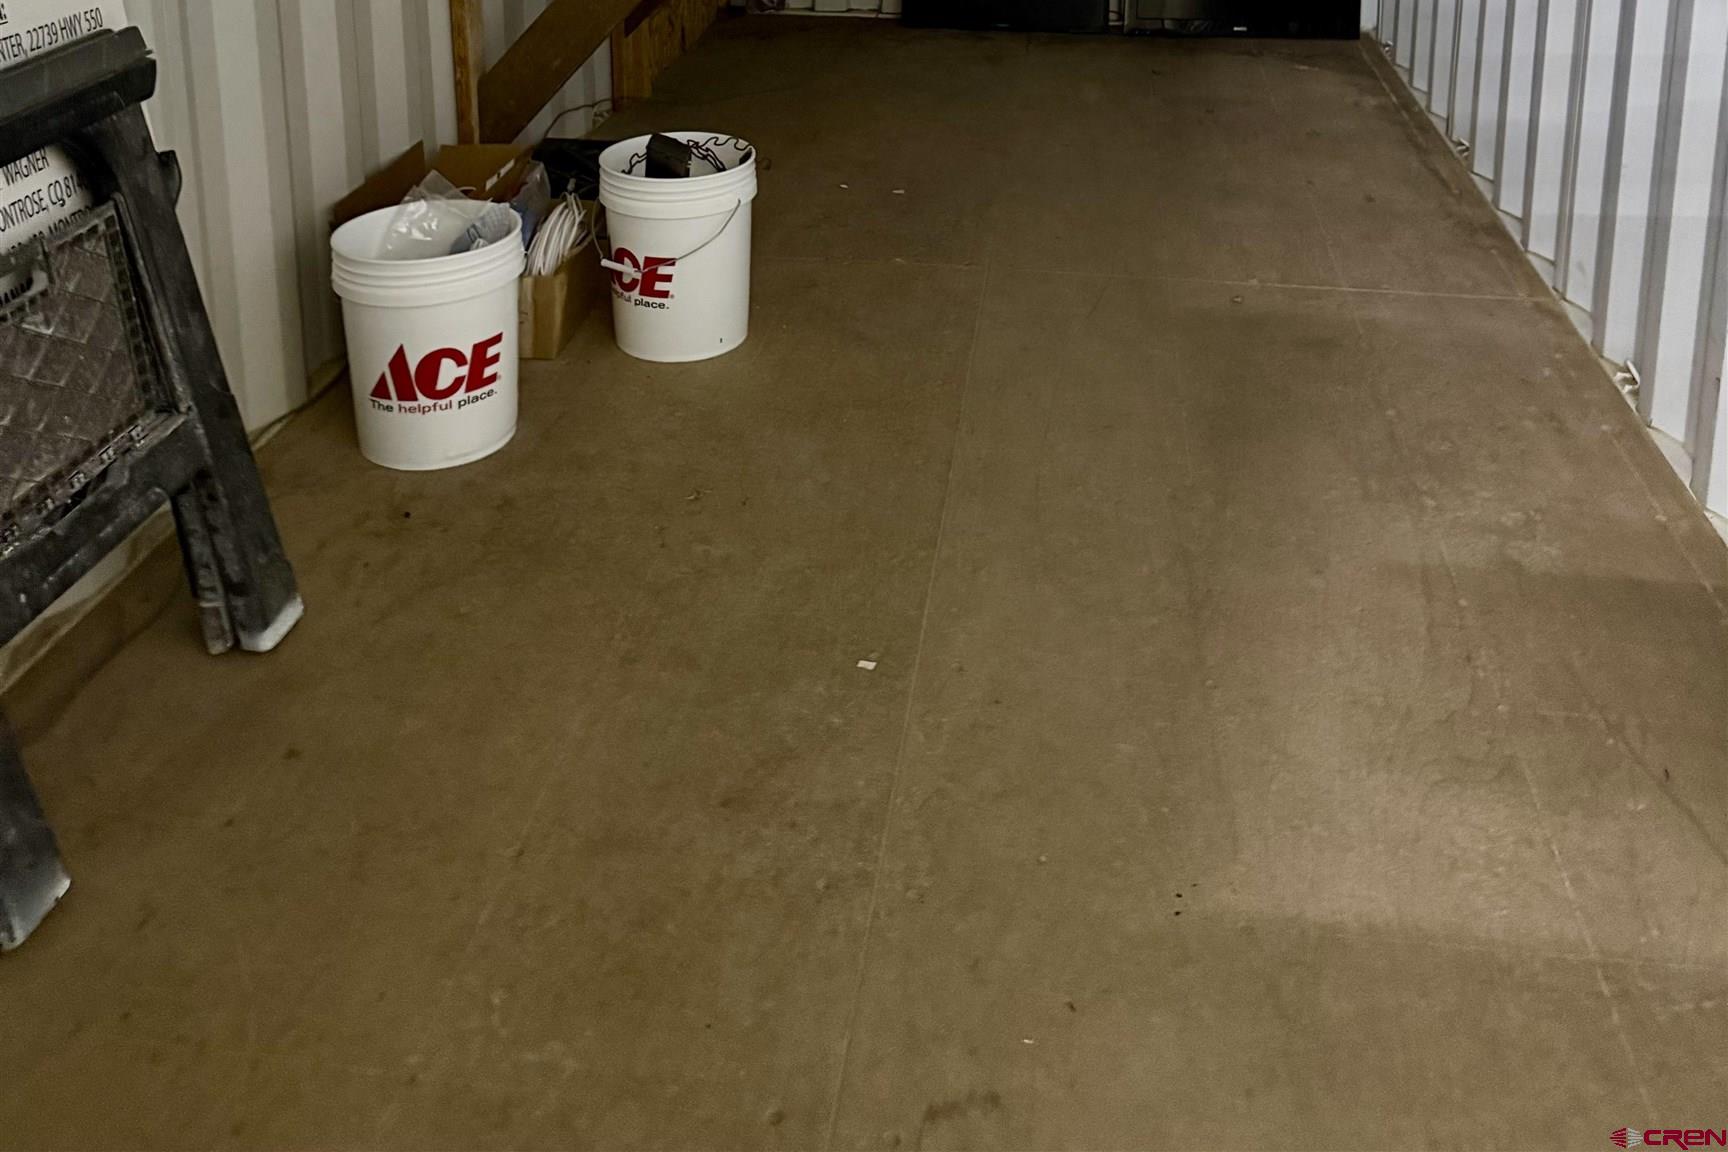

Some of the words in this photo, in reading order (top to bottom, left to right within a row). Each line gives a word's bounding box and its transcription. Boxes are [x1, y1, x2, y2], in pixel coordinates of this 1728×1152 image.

[26, 21, 59, 52] 22739
[58, 10, 84, 41] HWY
[83, 7, 104, 33] 550
[2, 146, 50, 186] WAGNER
[634, 297, 670, 310] place.
[369, 331, 503, 401] ACE
[369, 398, 394, 413] The
[397, 399, 453, 415] helpful
[456, 387, 499, 409] place.
